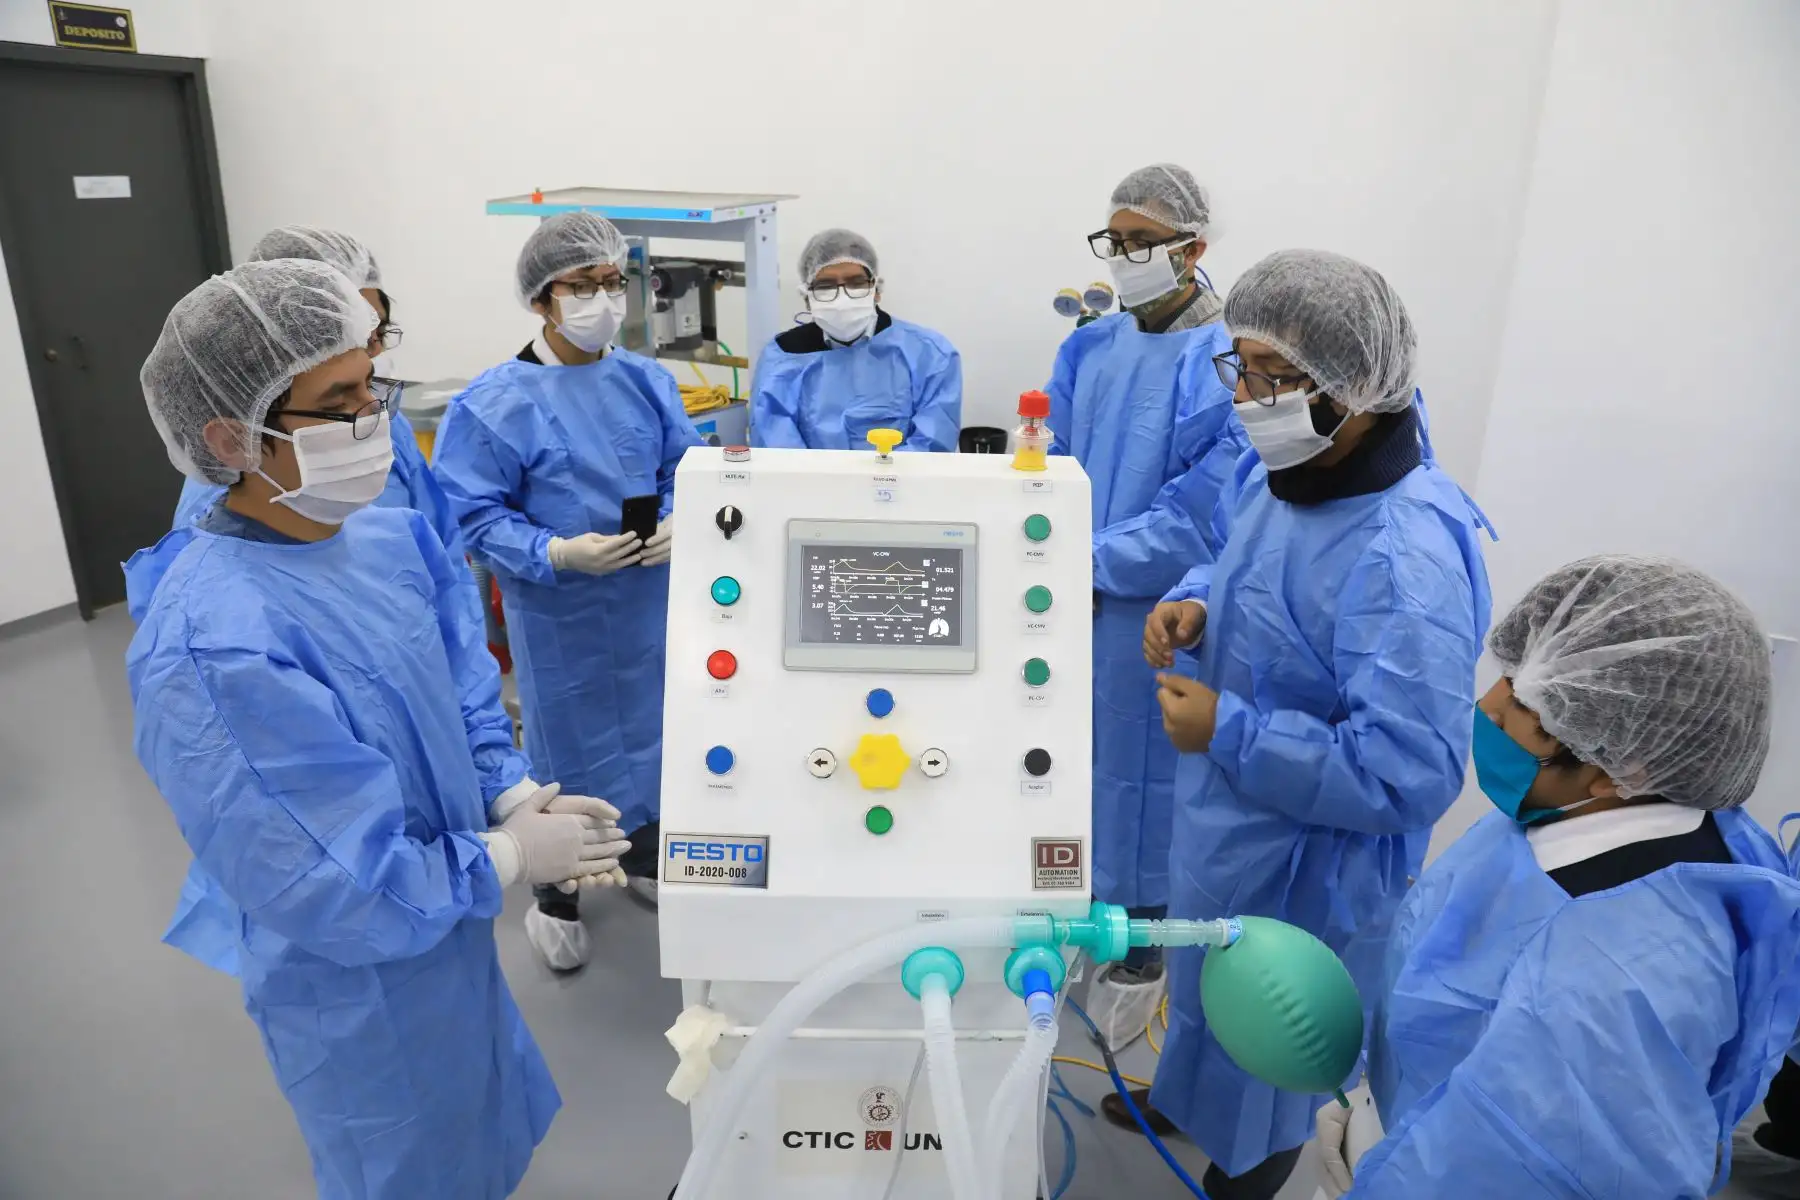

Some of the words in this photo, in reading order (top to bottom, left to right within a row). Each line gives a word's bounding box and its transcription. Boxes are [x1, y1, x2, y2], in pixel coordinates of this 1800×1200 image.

[63, 25, 125, 40] DEPOSITO
[669, 841, 763, 862] FESTO
[1042, 846, 1074, 864] ID
[684, 865, 747, 878] ID-2020-008
[782, 1130, 855, 1150] CTIC
[904, 1133, 943, 1151] UN
